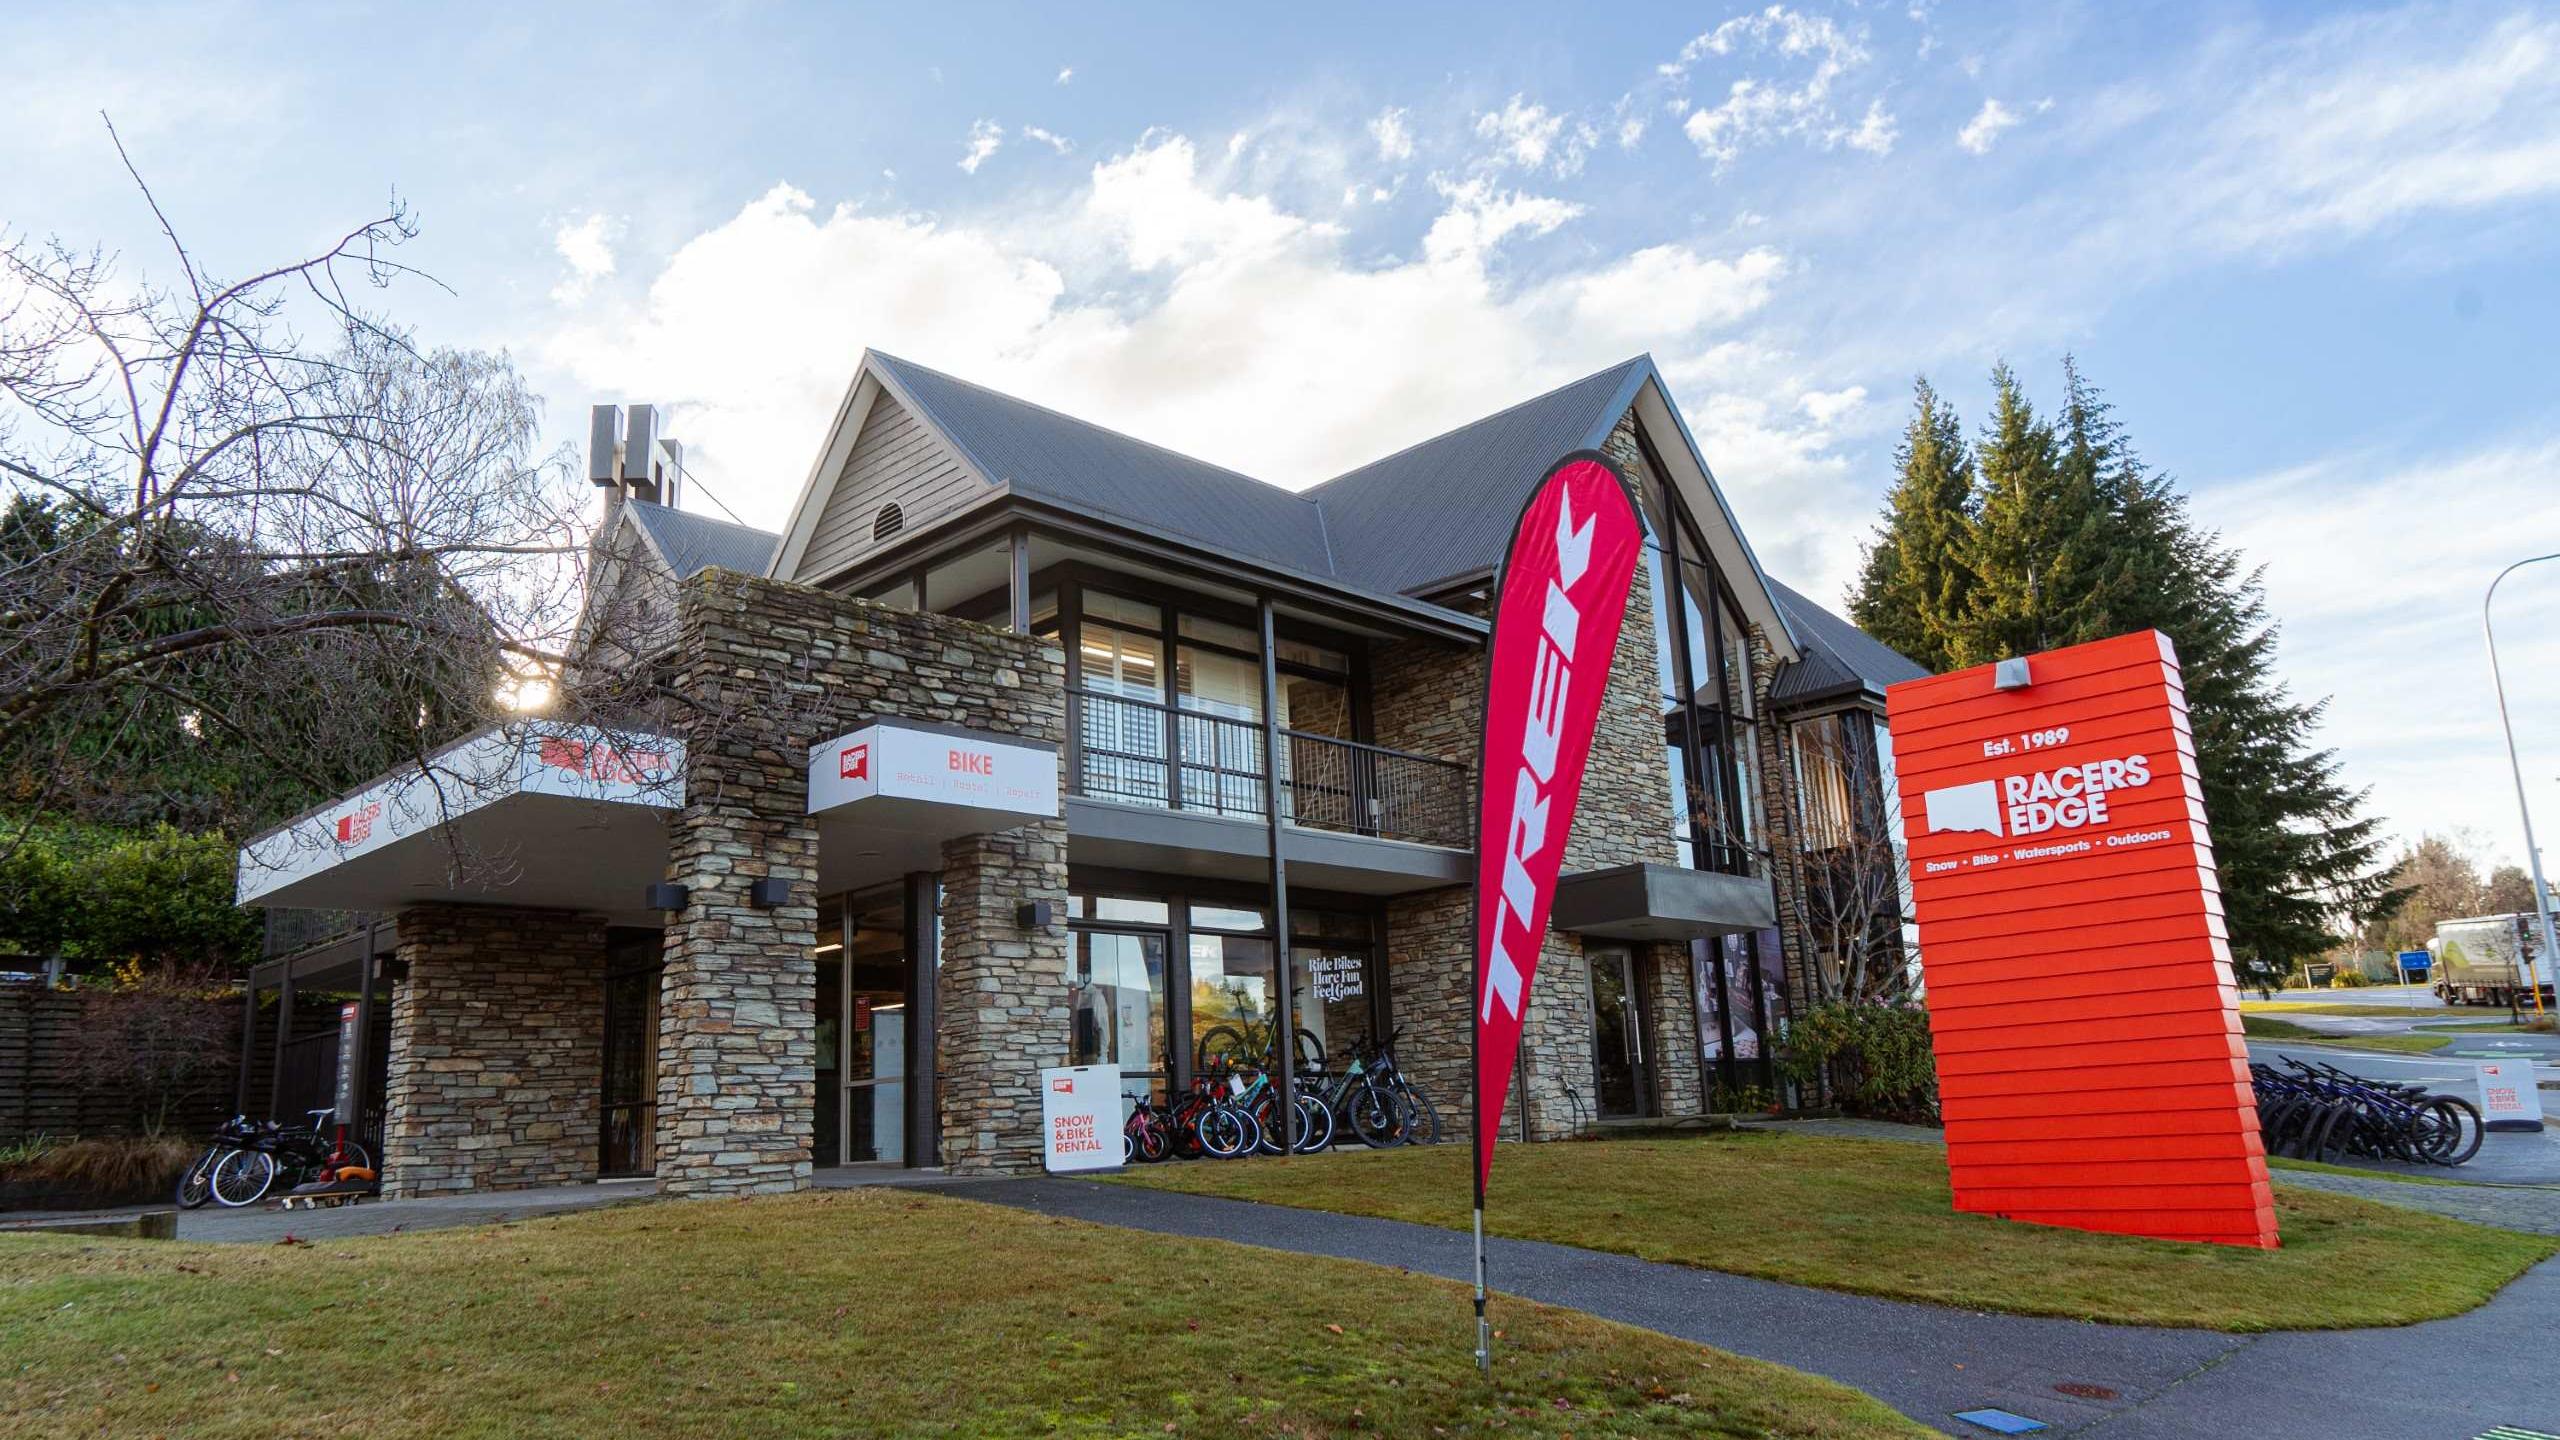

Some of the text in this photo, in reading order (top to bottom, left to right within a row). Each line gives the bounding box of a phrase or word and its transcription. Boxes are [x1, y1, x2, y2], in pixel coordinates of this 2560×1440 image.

[1481, 480, 1597, 1025] TREK
[1983, 727, 2070, 758] Est. 1989
[948, 750, 993, 776] BIKE
[2004, 754, 2151, 807] RACERS
[2008, 792, 2110, 837] EDGE
[1926, 829, 2171, 873] Snow Bike Watersports Outdoors
[1308, 956, 1362, 972] Ride Bikes
[1055, 1115, 1094, 1128] SNOW
[1056, 1128, 1094, 1140] & BIKE
[1056, 1140, 1102, 1153] RENTAL
